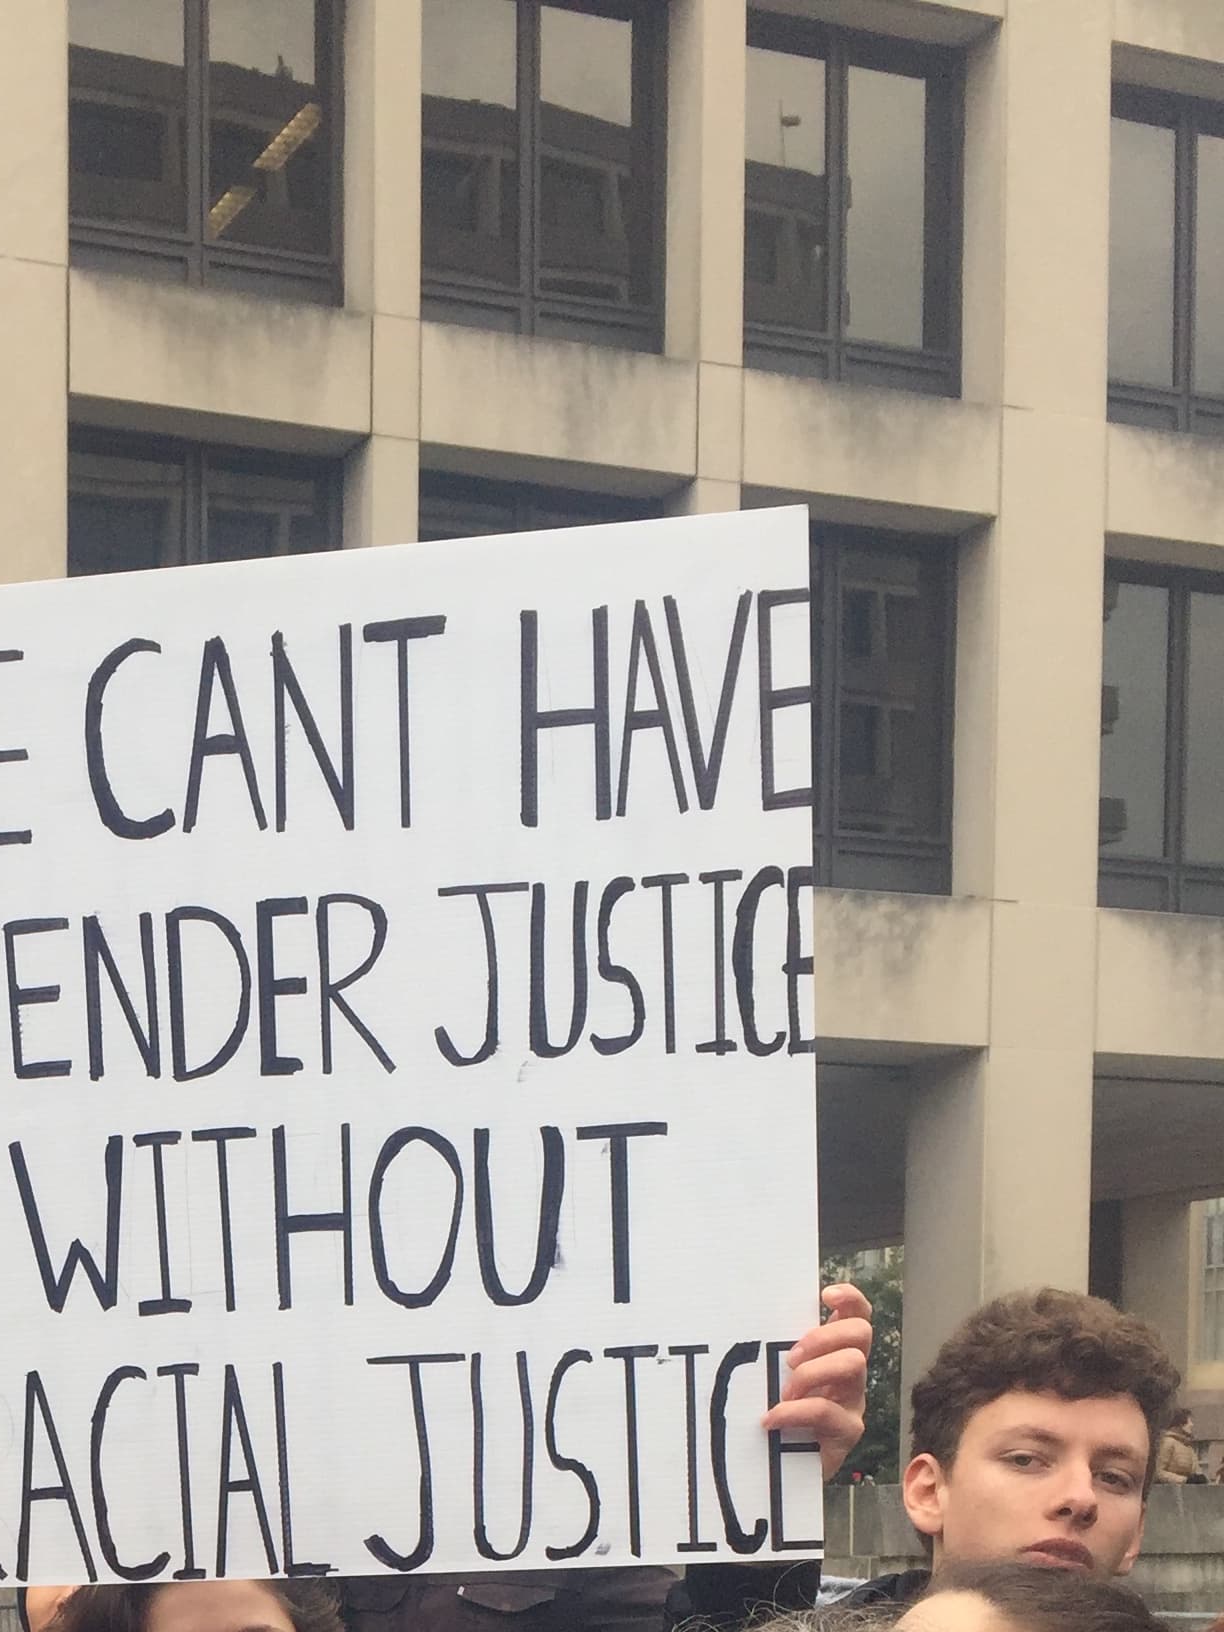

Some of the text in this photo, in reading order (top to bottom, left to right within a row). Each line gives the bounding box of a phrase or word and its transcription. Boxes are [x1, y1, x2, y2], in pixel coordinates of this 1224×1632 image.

[84, 614, 447, 841] CANT
[520, 588, 812, 828] HAVE
[434, 865, 815, 1067] JUSTICE
[8, 1121, 669, 1317] WITHOUT
[364, 1340, 823, 1573] JUSTICE
